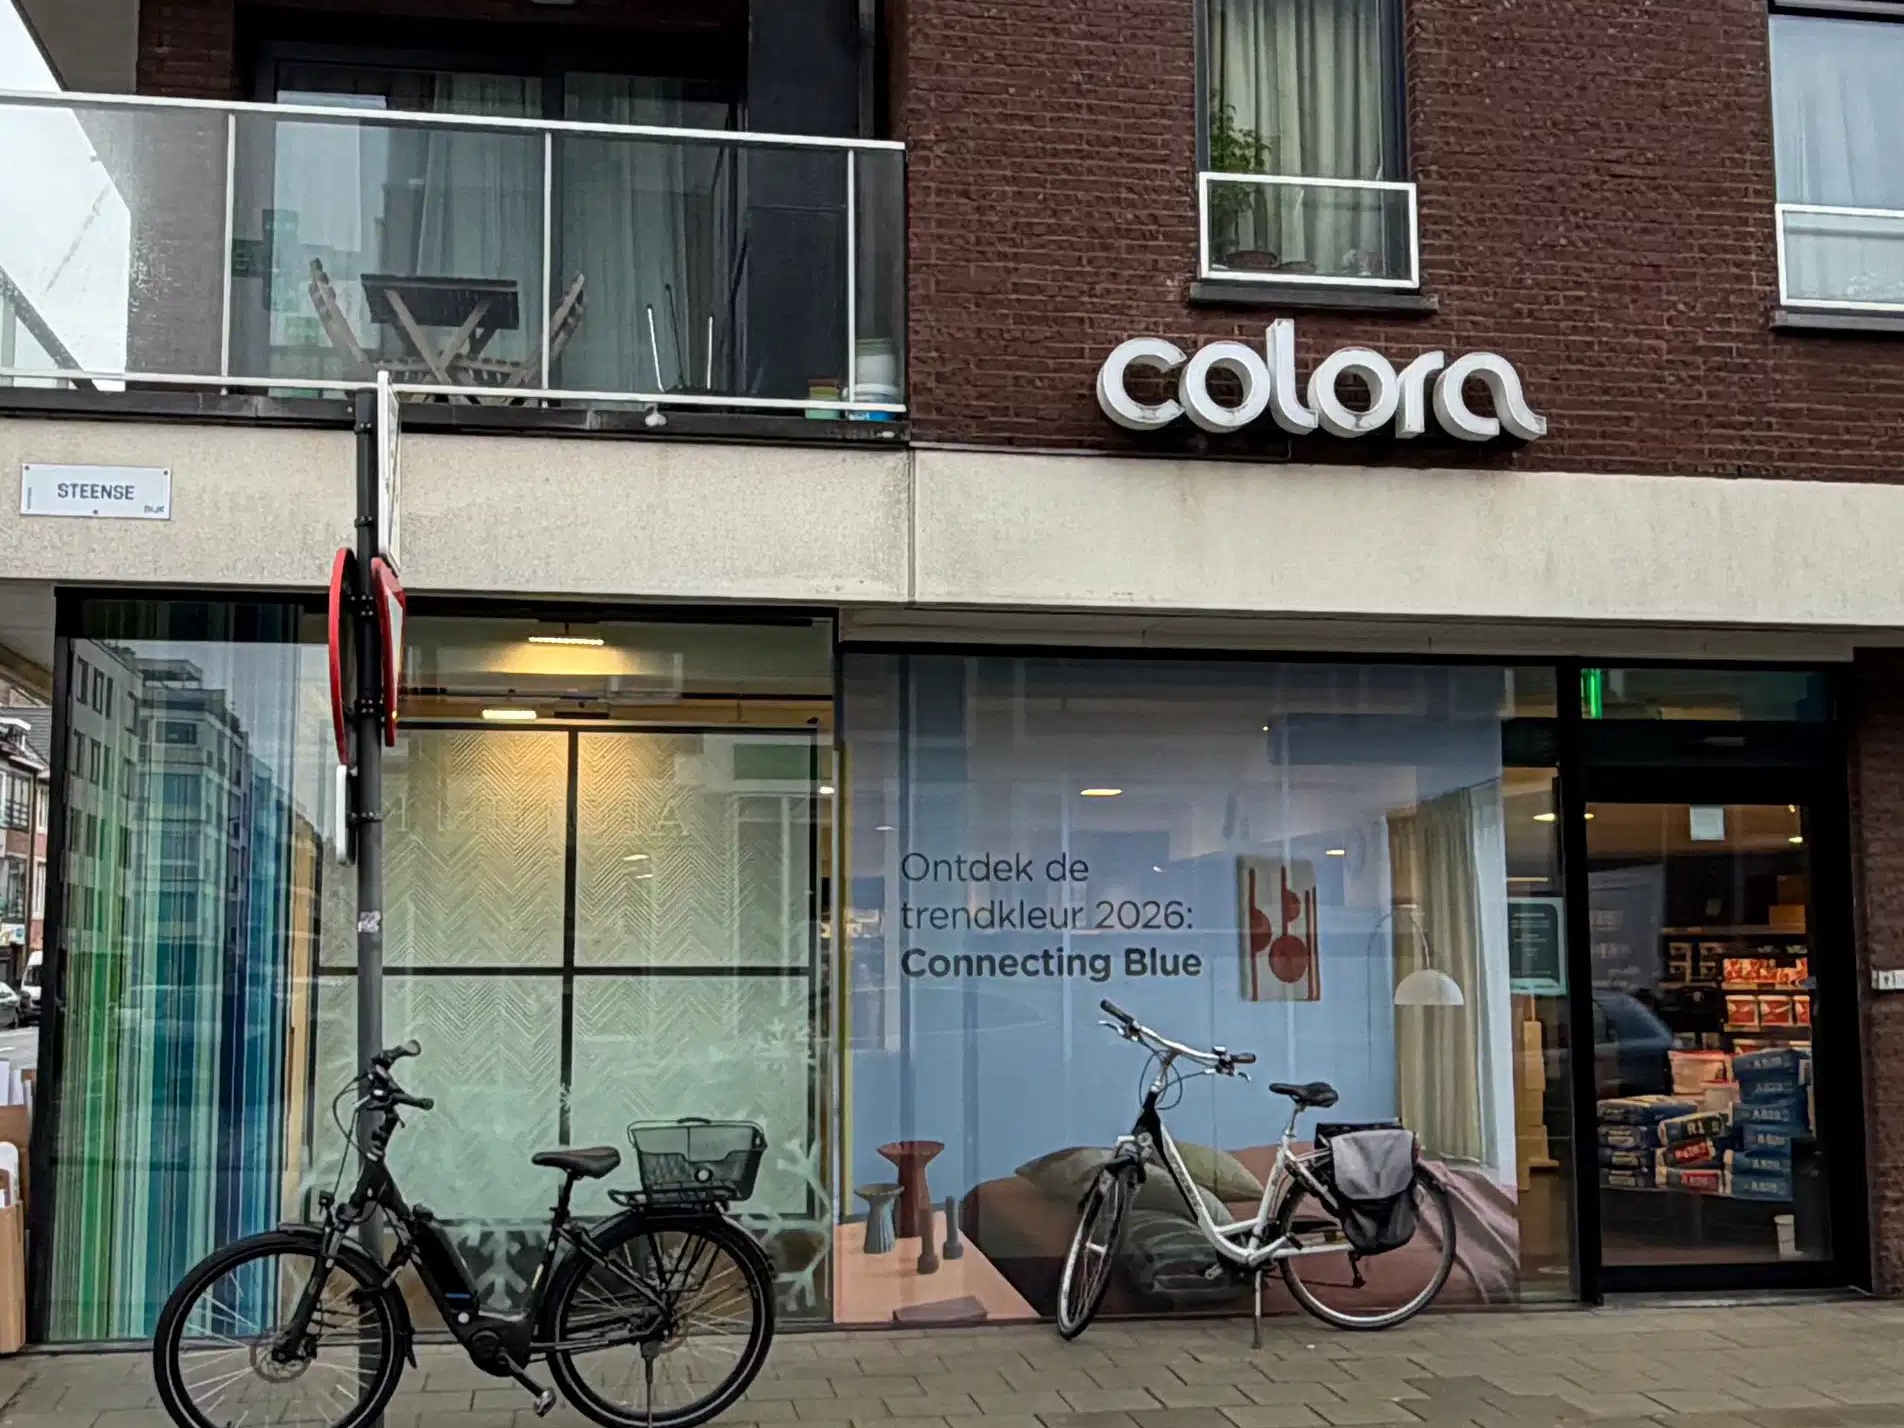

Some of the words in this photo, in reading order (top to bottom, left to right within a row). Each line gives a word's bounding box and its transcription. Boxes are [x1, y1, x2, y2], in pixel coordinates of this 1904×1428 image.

[1096, 317, 1547, 441] colora
[57, 482, 135, 501] STEENSE
[901, 852, 1033, 883] Ontdek
[1046, 852, 1090, 883] de
[900, 899, 1084, 929] trendkleur
[1095, 900, 1193, 929] 2026:
[901, 946, 1111, 983] Connecting
[1124, 947, 1203, 977] Blue
